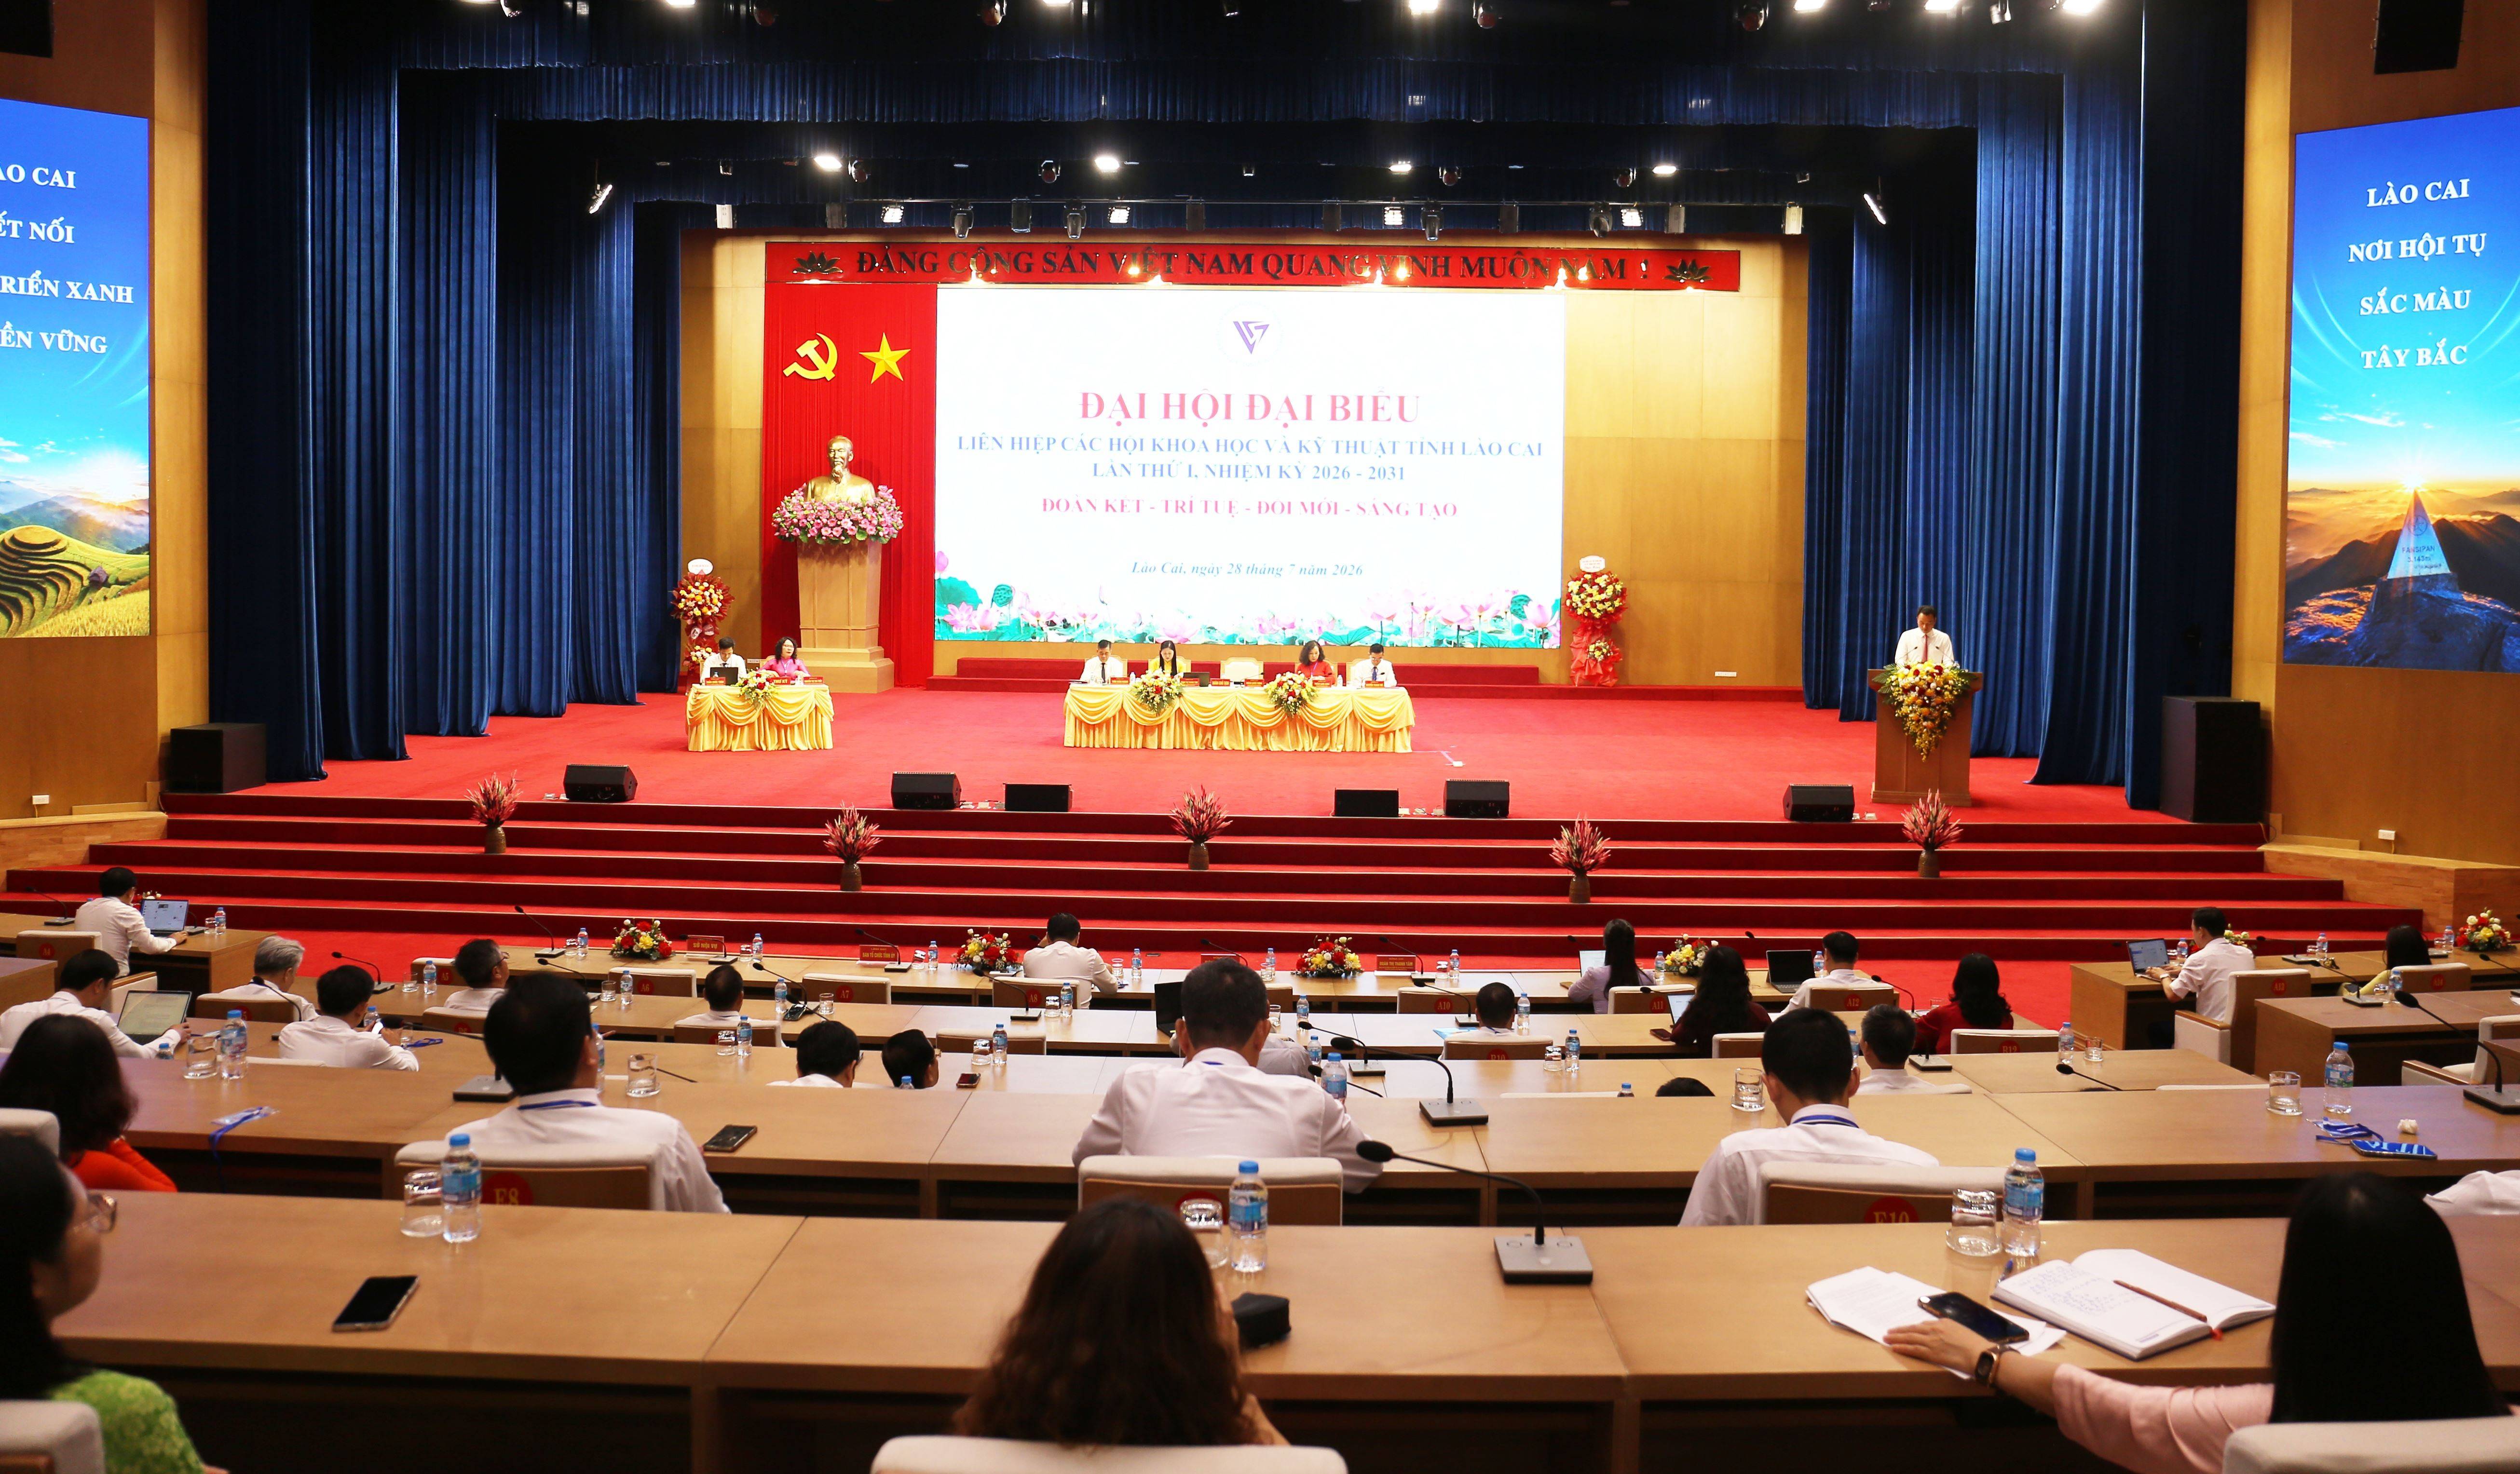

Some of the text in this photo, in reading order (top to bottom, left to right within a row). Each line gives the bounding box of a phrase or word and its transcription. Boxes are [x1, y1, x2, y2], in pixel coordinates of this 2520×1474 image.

[32, 167, 76, 189] CAI
[2367, 178, 2470, 207] LÀO CAI
[29, 216, 75, 244] NỐI
[2348, 232, 2487, 263] NƠI HỘI TỤ
[857, 245, 939, 274] ĐẢNG
[948, 246, 1034, 278] CỘNG
[1043, 245, 1099, 274] SẢN
[1109, 246, 1176, 278] VIỆT
[1186, 253, 1253, 275] NAM
[1262, 253, 1371, 280] QUANG
[1376, 255, 1451, 278] VINH
[1460, 251, 1550, 279] MUÔN
[1560, 254, 1626, 280] NĂM
[0, 270, 134, 304] RIỂN XANH
[2360, 286, 2472, 315] SẮC MÀU
[39, 329, 108, 354] VỮNG
[2361, 338, 2467, 369] TÂY BẮC
[1079, 392, 1146, 427] ĐẠI
[1162, 389, 1232, 428] HỘI
[1245, 394, 1313, 429] ĐẠI
[958, 432, 1003, 450] LIÊN
[1011, 433, 1056, 455] HIỆP
[1060, 433, 1102, 451] CÁC
[1109, 436, 1144, 455] HỘI
[1151, 437, 1209, 454] KHOA
[1216, 438, 1258, 457] HỌC
[1264, 435, 1291, 453] VÀ
[1298, 436, 1326, 454] KỸ
[1331, 438, 1400, 457] THUẬT
[1460, 437, 1502, 456] LÀO
[1507, 442, 1542, 457] CAI
[1138, 459, 1183, 478] THỨ
[1278, 461, 1306, 479] KỲ
[1312, 465, 1350, 480] 2026
[1368, 466, 1404, 481] 2031
[1417, 502, 1457, 520] TẠO
[1131, 561, 1363, 578] Lào Cai, ngày 28 tháng 7 năm 2026
[640, 984, 650, 992] A6
[840, 990, 849, 998] A7
[1029, 994, 1037, 1002] A8
[1437, 1001, 1450, 1010] A10
[1652, 1001, 1663, 1010] A11
[1847, 998, 1859, 1006] A12
